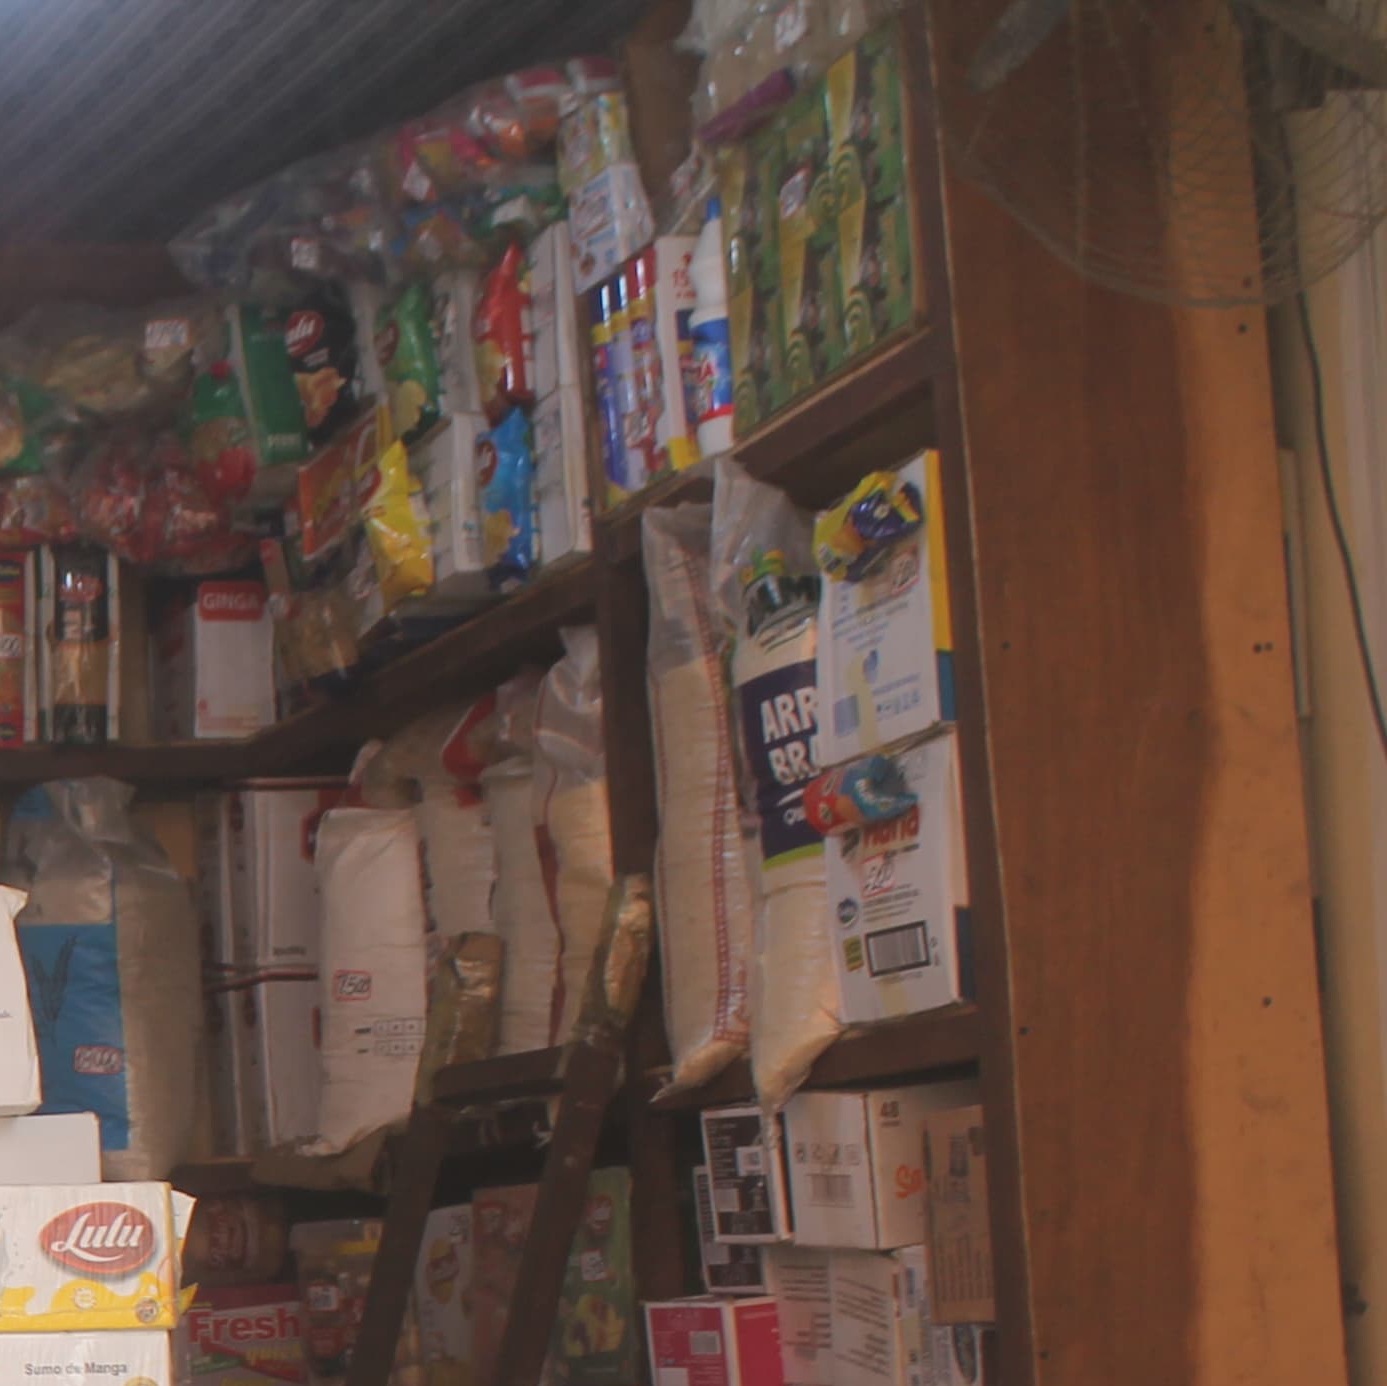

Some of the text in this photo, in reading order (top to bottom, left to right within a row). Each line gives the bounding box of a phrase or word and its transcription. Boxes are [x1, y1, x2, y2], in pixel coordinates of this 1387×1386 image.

[52, 1211, 144, 1263] Lulu
[187, 1308, 300, 1344] Fresh
[24, 1362, 61, 1376] Sumo
[85, 1361, 128, 1377] Manga
